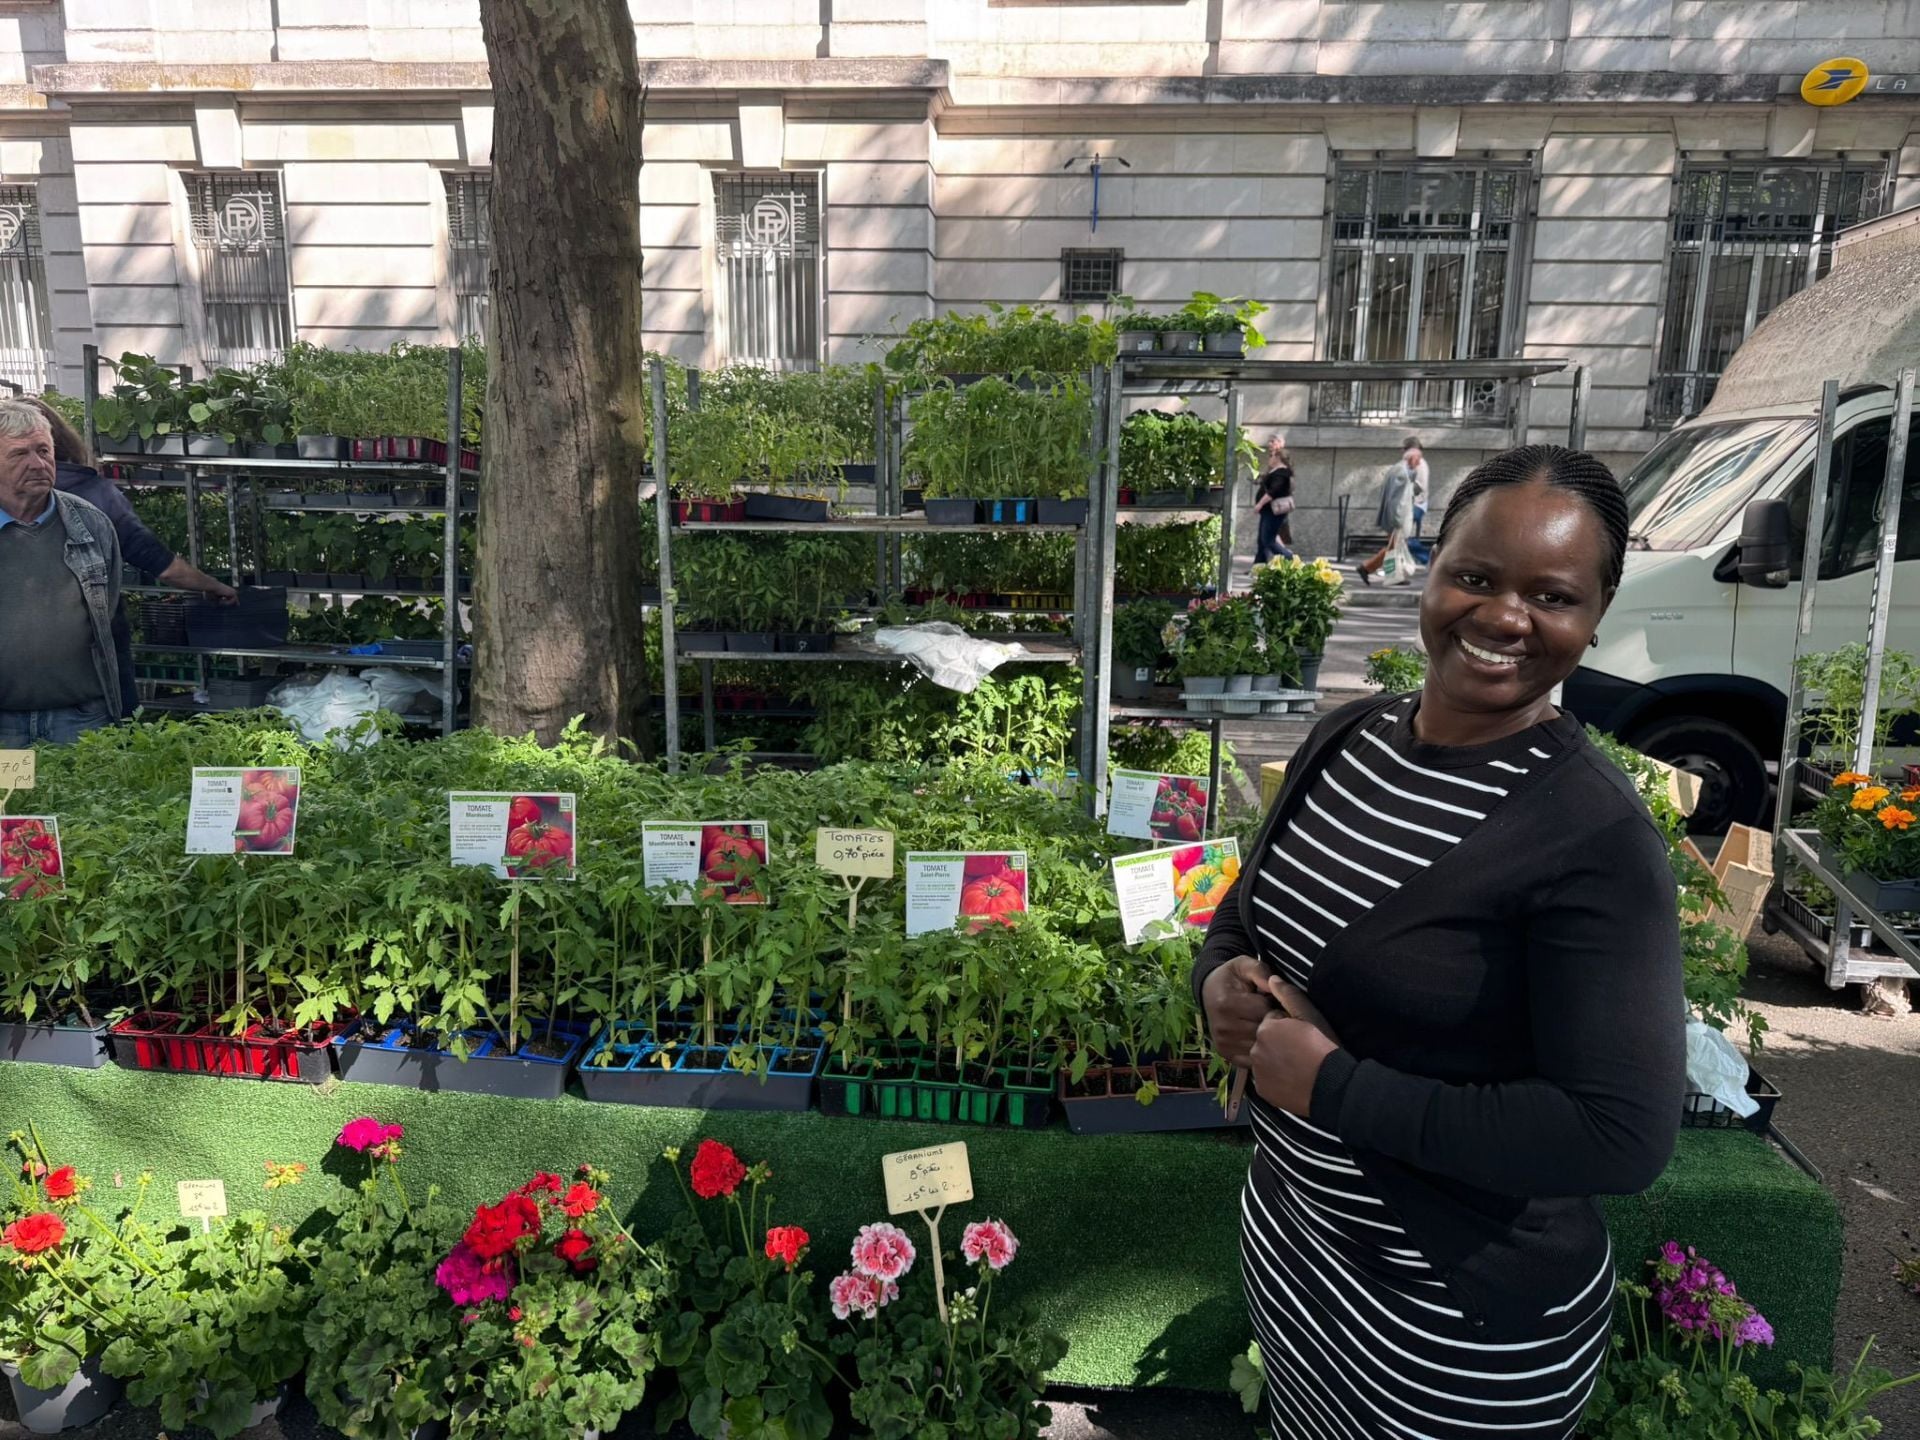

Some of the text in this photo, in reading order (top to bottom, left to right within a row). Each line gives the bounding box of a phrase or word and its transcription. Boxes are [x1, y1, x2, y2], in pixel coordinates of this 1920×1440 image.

[1876, 79, 1907, 90] LA
[467, 804, 492, 812] TOMATE
[660, 833, 684, 841] TOMATE
[824, 830, 884, 843] TOMATES
[923, 864, 948, 872] TOMATE
[1130, 863, 1156, 874] TOMATE
[942, 1181, 949, 1191] 2
